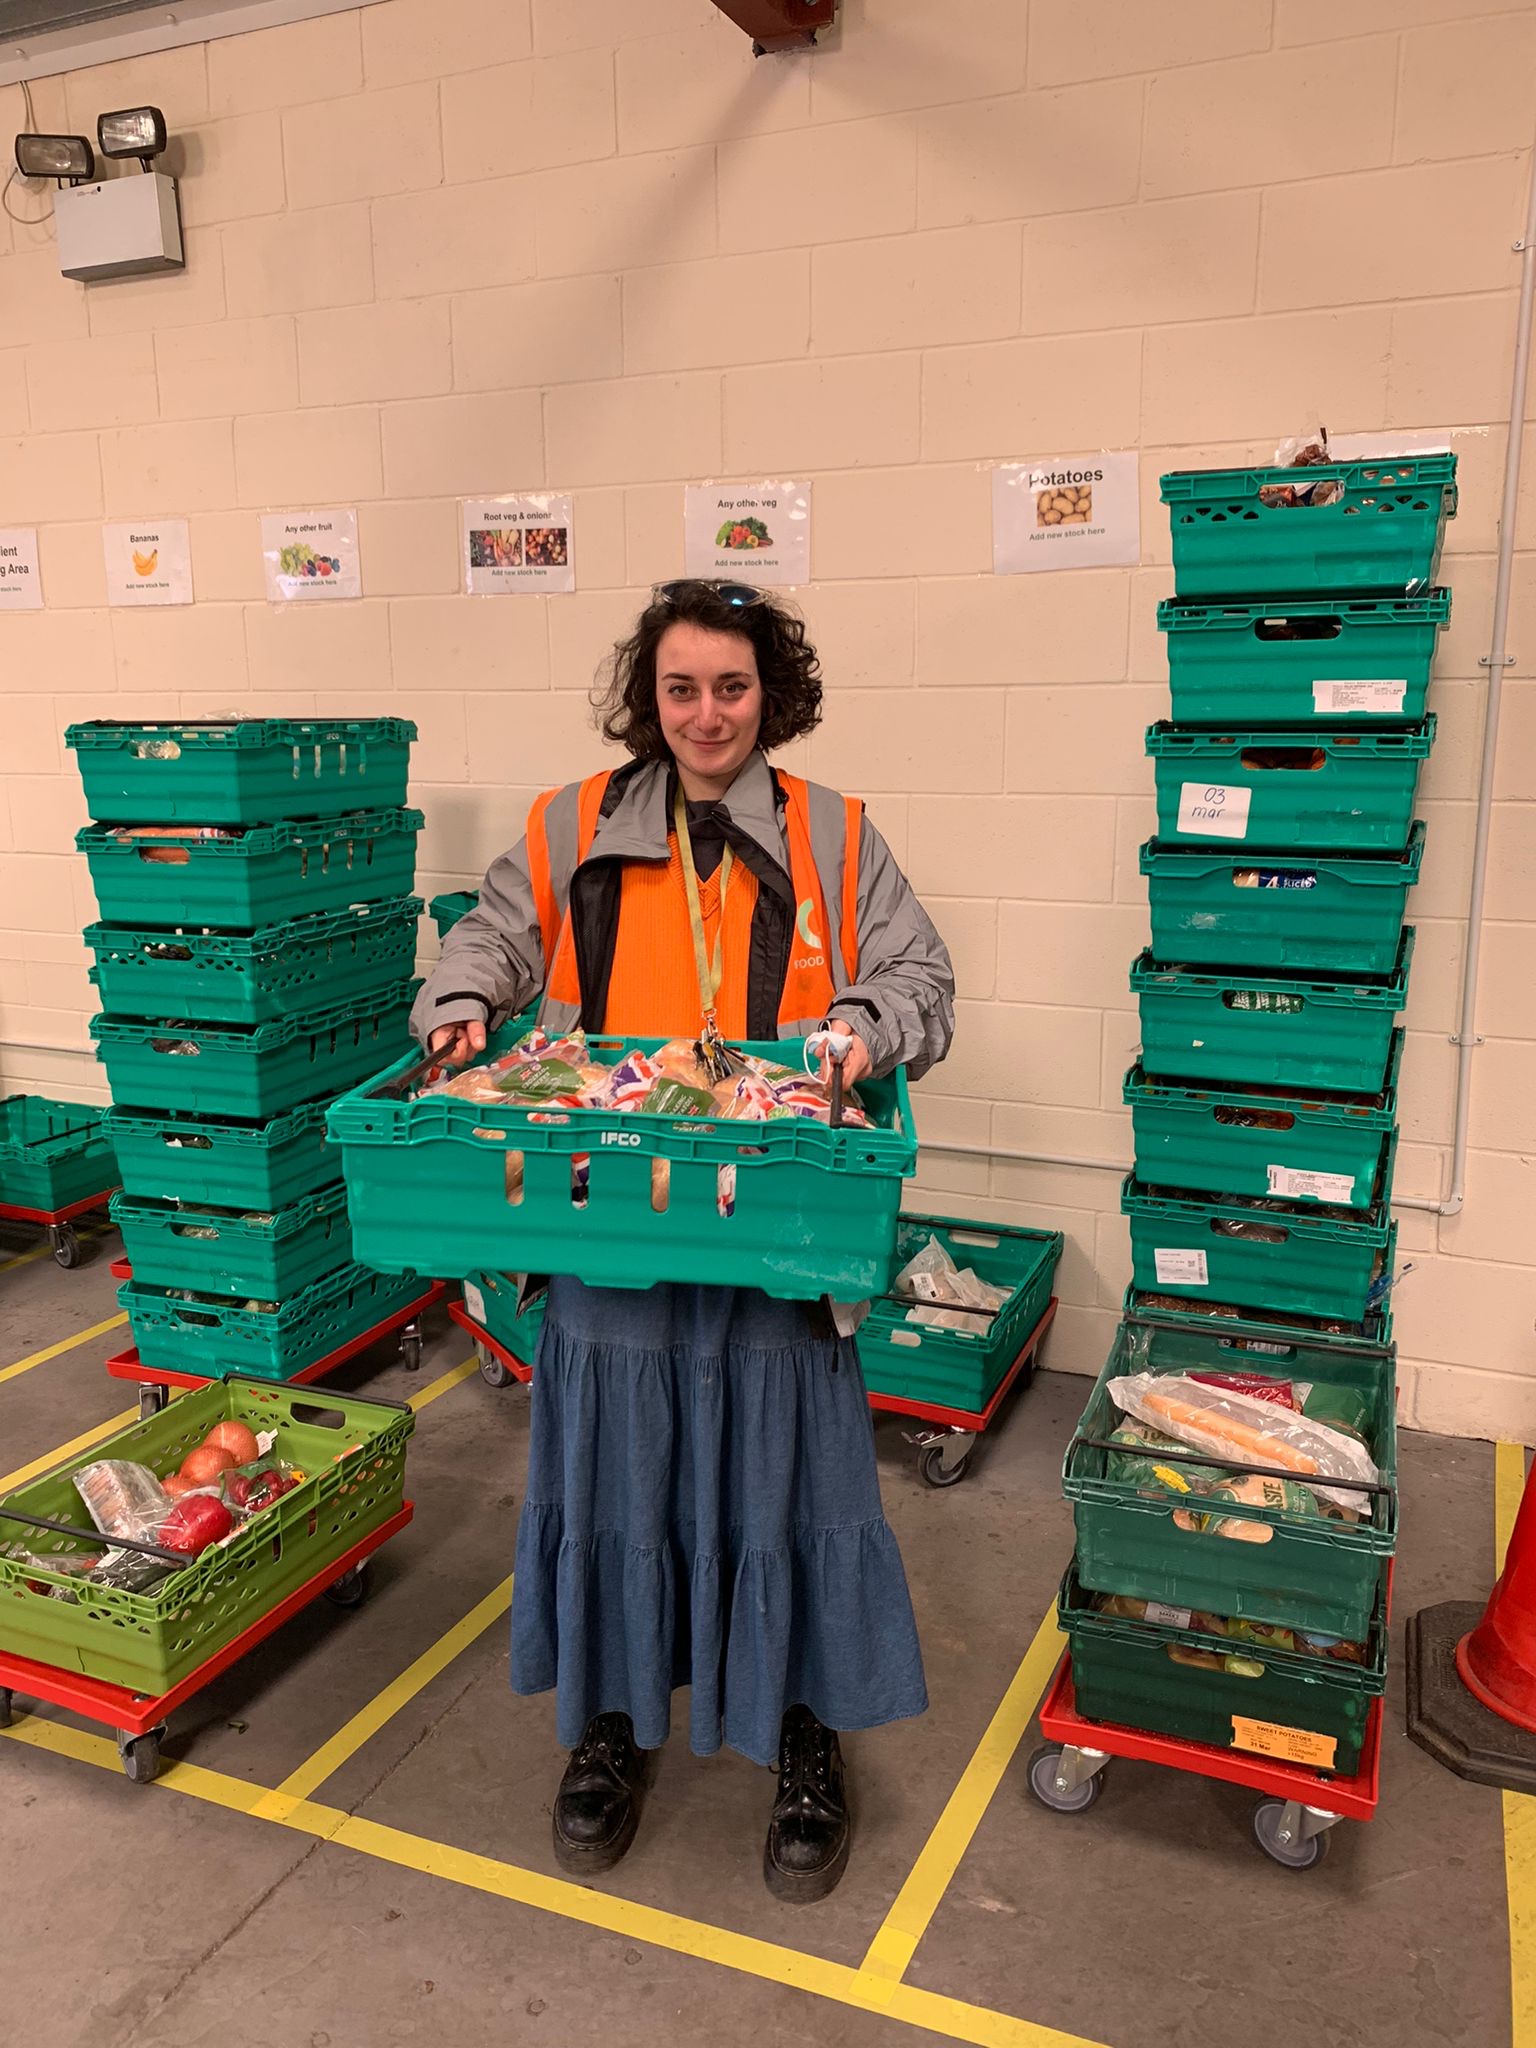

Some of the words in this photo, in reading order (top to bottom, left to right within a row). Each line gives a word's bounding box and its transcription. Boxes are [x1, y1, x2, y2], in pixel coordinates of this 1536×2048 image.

[1028, 469, 1104, 489] Potatoes
[717, 499, 734, 510] Any
[761, 499, 777, 509] veg
[483, 512, 502, 521] Root
[503, 513, 518, 522] veg
[518, 511, 525, 520] &
[284, 525, 299, 535] Any
[299, 524, 317, 532] other
[318, 522, 333, 531] fruit
[1029, 533, 1045, 541] Add
[1046, 531, 1063, 540] new
[1064, 529, 1086, 538] stock
[1087, 527, 1106, 535] here
[129, 534, 160, 543] Bananas
[8, 563, 30, 575] Area
[714, 559, 729, 567] Add
[491, 568, 504, 576] Add
[1204, 787, 1226, 805] 03
[1191, 806, 1227, 819] mar
[794, 955, 825, 970] FOOD
[600, 1131, 641, 1146] IFCO
[1278, 1730, 1312, 1742] POTATOES
